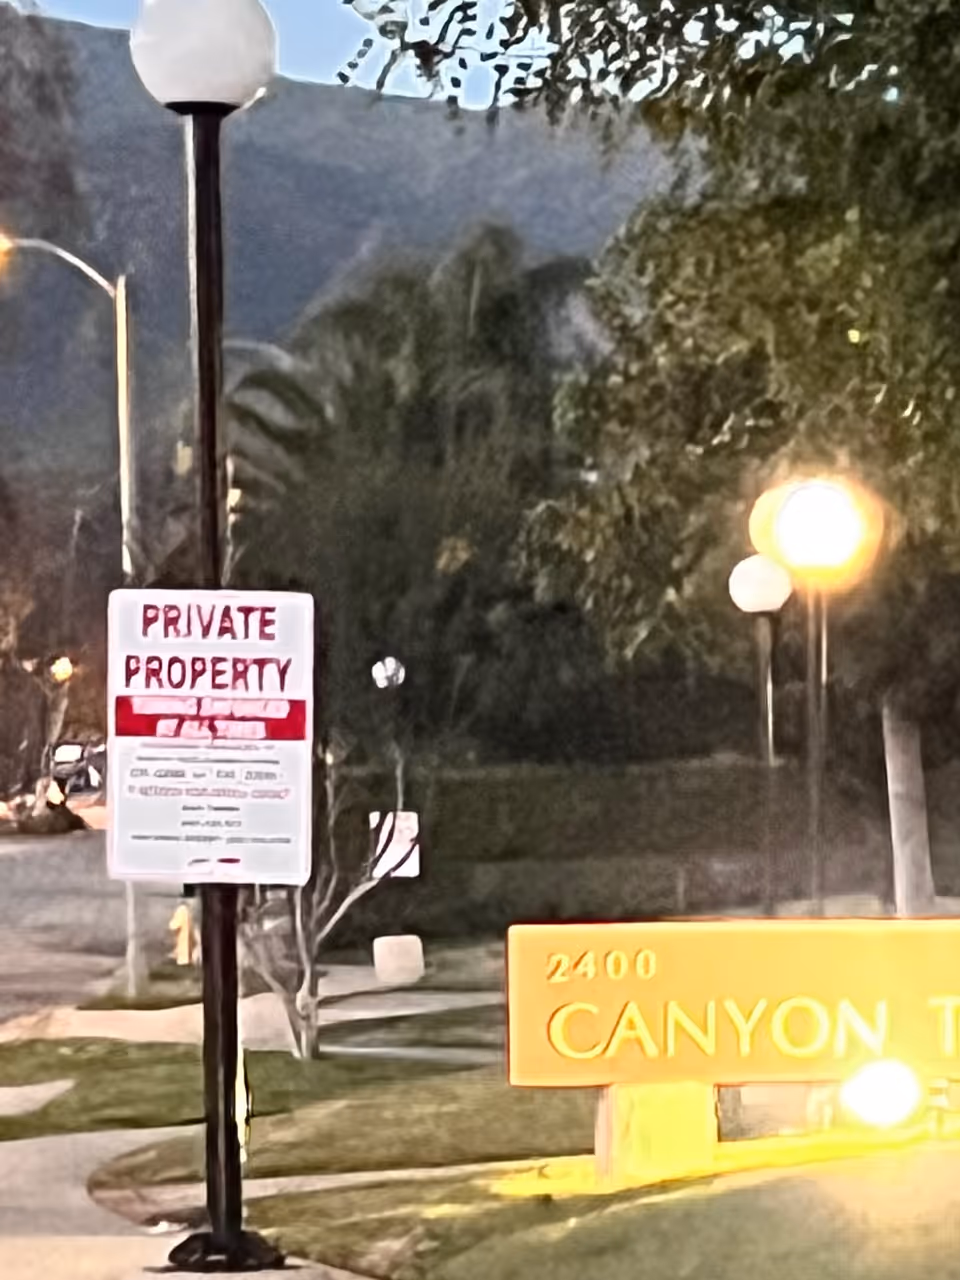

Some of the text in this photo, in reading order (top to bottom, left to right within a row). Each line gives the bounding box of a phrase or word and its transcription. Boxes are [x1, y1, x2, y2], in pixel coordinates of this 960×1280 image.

[142, 604, 277, 641] PRIVATE
[125, 655, 292, 692] PROPERTY
[547, 949, 657, 983] 2400
[547, 997, 888, 1059] CANYON
